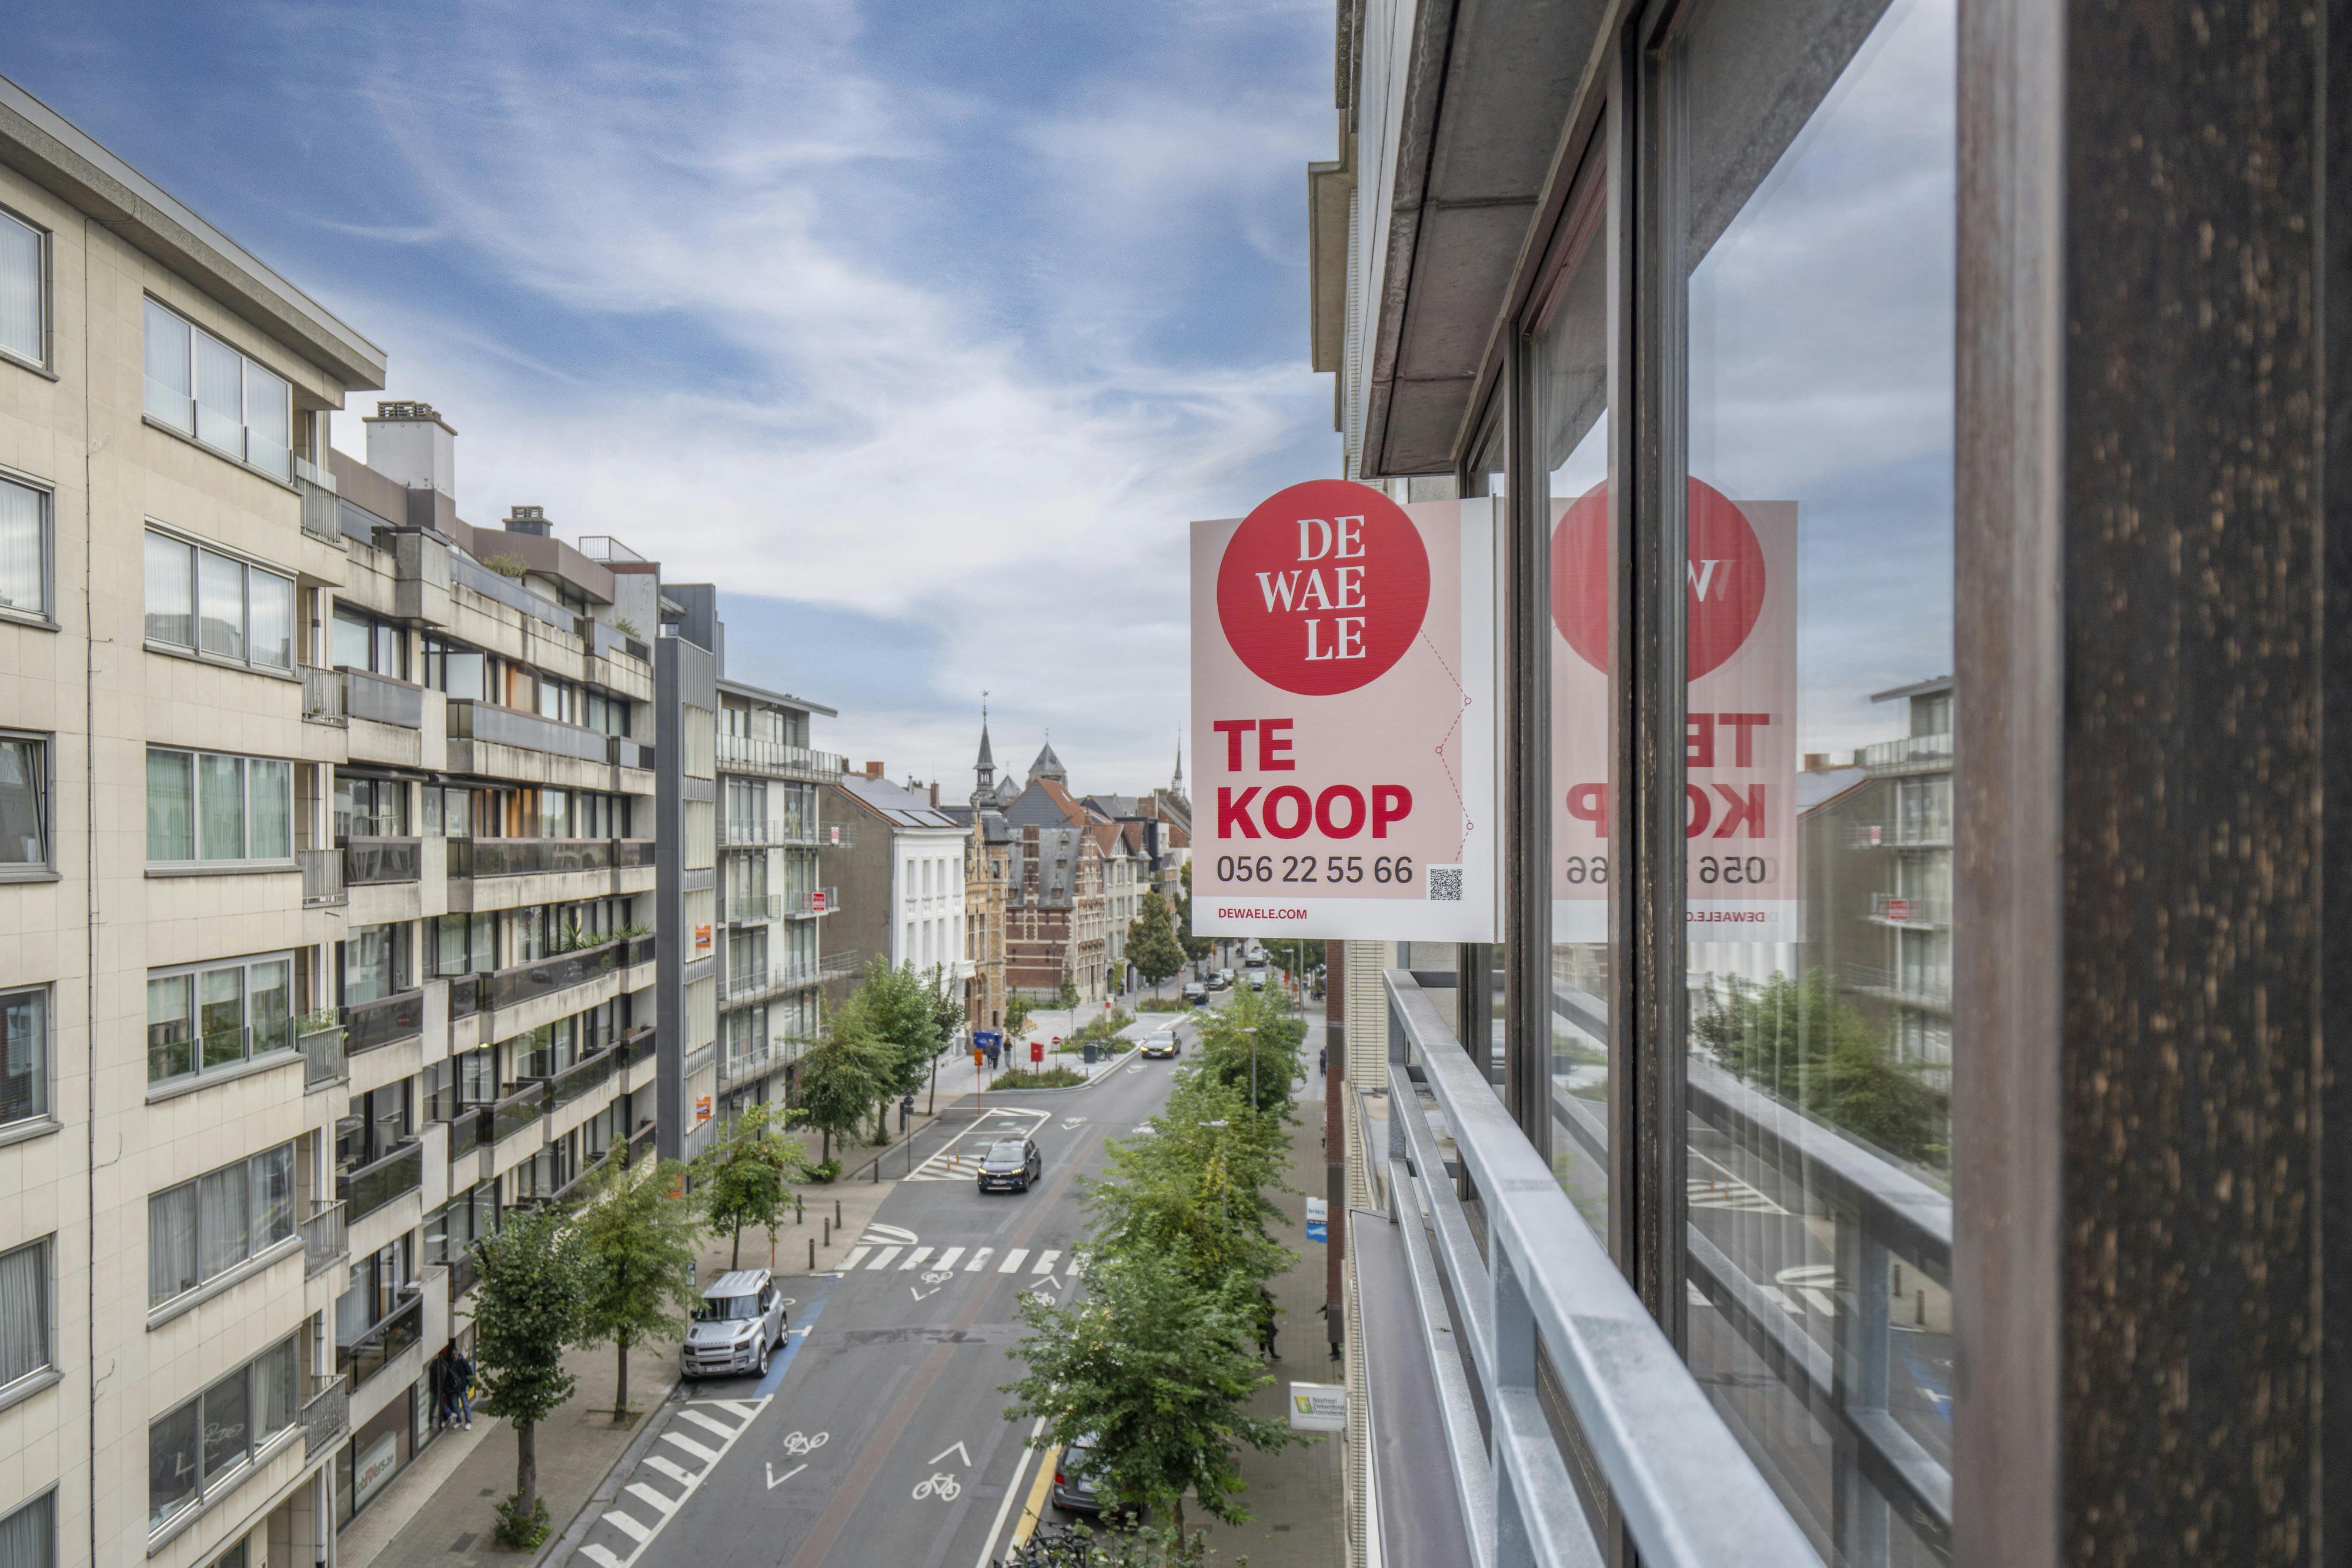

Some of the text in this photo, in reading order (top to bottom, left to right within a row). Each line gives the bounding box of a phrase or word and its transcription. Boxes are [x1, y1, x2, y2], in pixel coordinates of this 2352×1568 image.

[1297, 515, 1365, 561] DE
[1255, 566, 1366, 613] WAE
[1305, 616, 1367, 661] LE
[1213, 718, 1296, 772] TE
[1217, 784, 1412, 840] KOOP
[1217, 855, 1413, 884] 056 22 55 66
[1218, 908, 1308, 921] DEWAELE.COM
[1312, 1403, 1345, 1412] Ziekenfond
